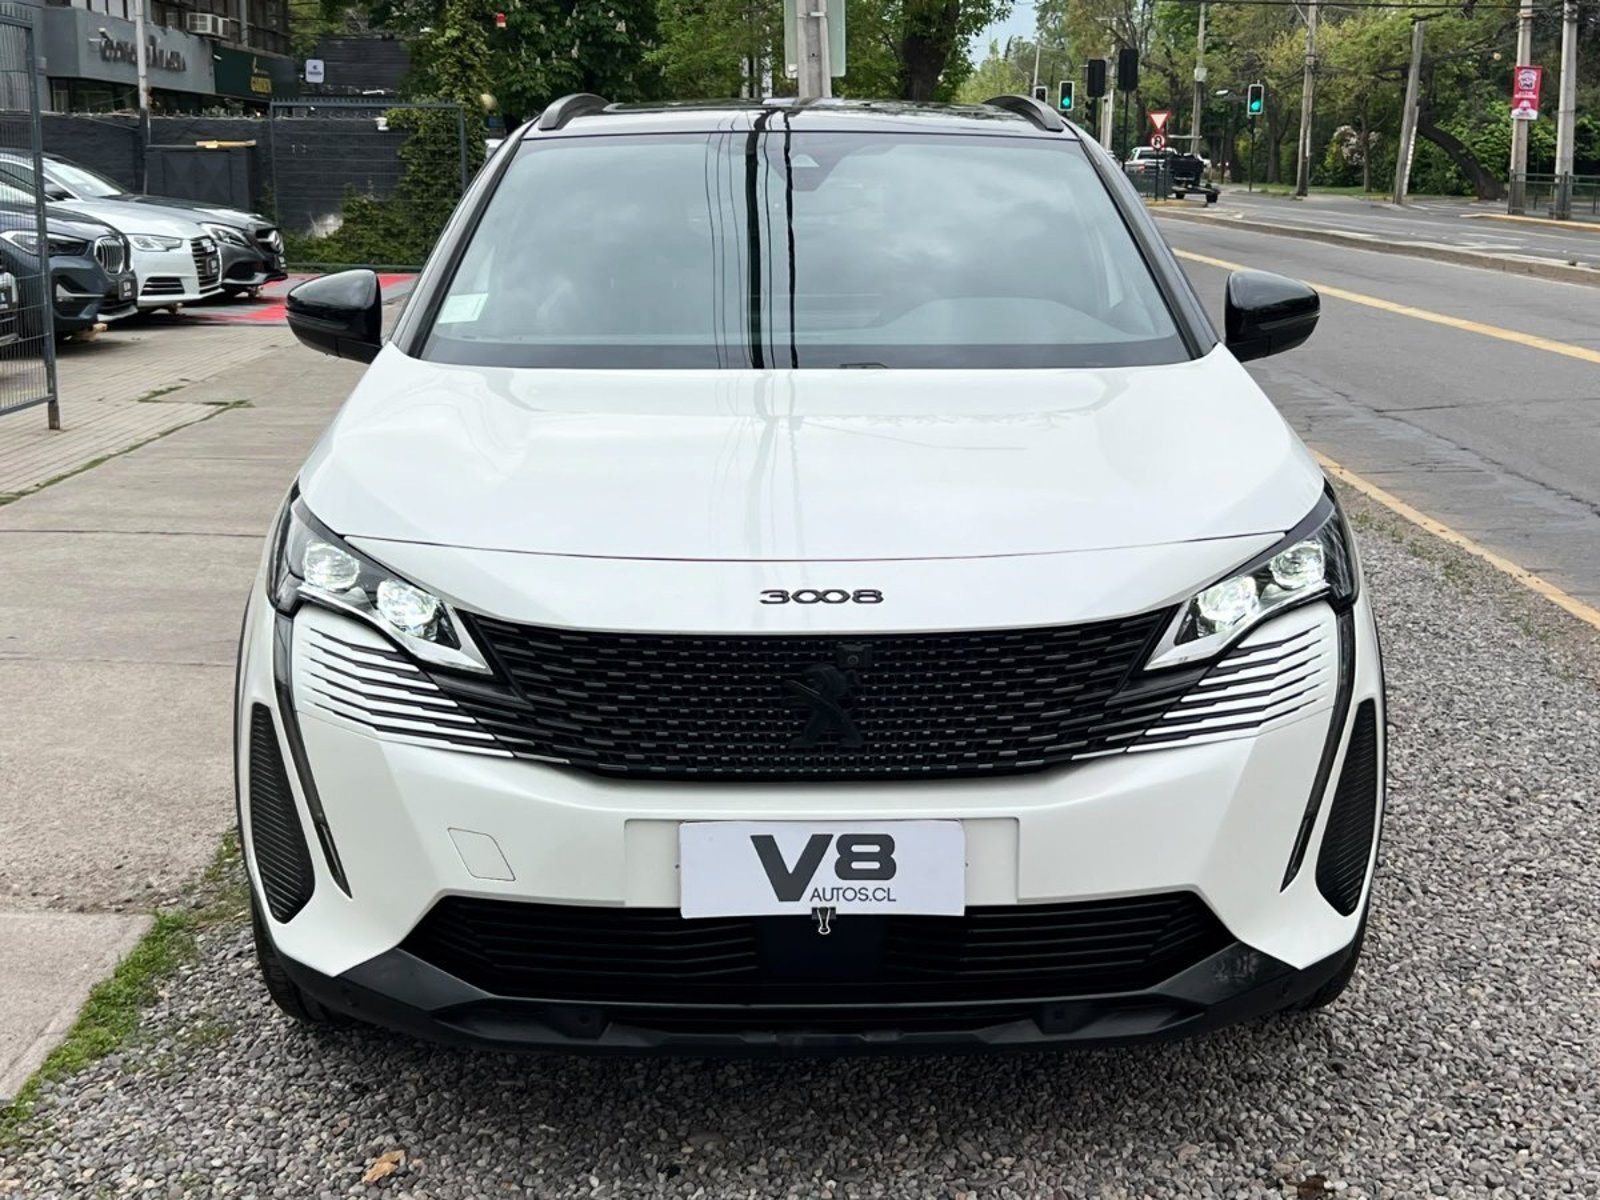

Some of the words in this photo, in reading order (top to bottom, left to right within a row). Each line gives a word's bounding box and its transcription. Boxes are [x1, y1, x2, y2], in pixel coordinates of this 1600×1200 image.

[759, 589, 884, 604] 3008
[750, 833, 897, 902] V8
[809, 887, 897, 903] AUTOS.CL
